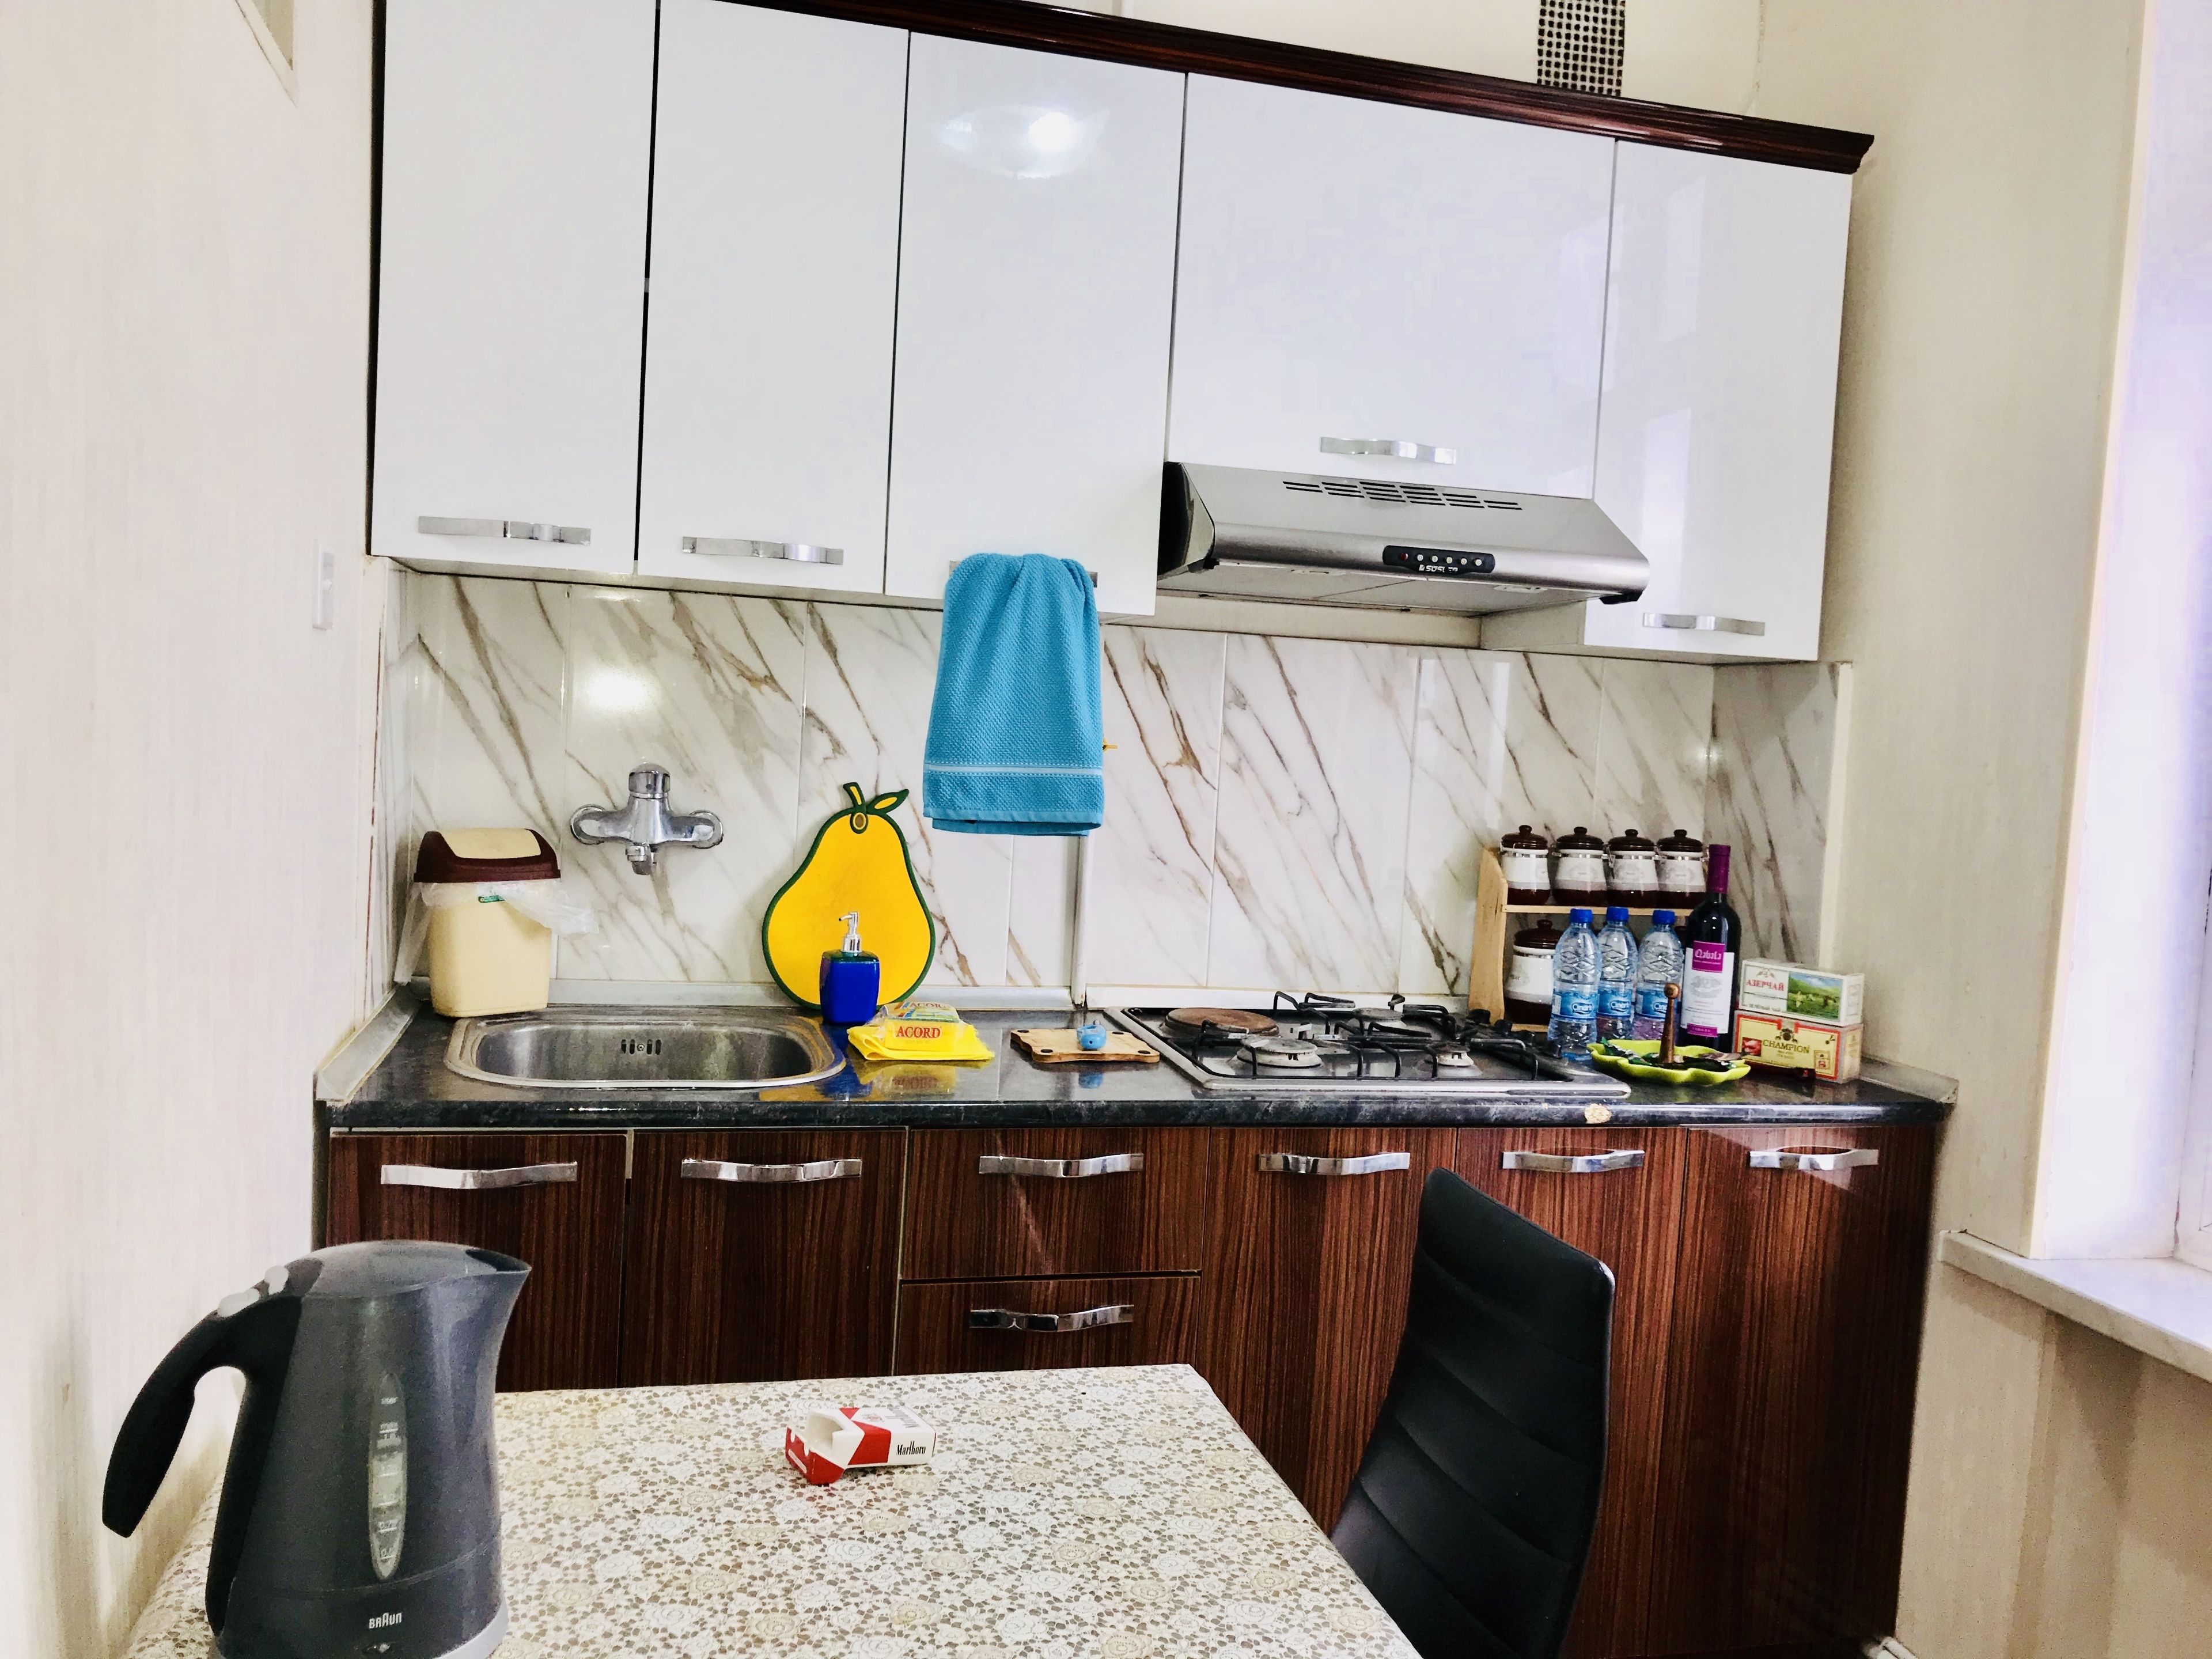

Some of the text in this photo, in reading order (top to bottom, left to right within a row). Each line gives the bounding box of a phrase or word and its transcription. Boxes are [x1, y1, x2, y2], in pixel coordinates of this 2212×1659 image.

[1746, 980, 1784, 991] АЗЕРЧАЙ
[896, 1027, 941, 1038] ACORD
[1763, 1039, 1809, 1053] CHAMPION
[896, 1441, 926, 1455] Marlboro
[369, 1612, 402, 1629] BRAUN
